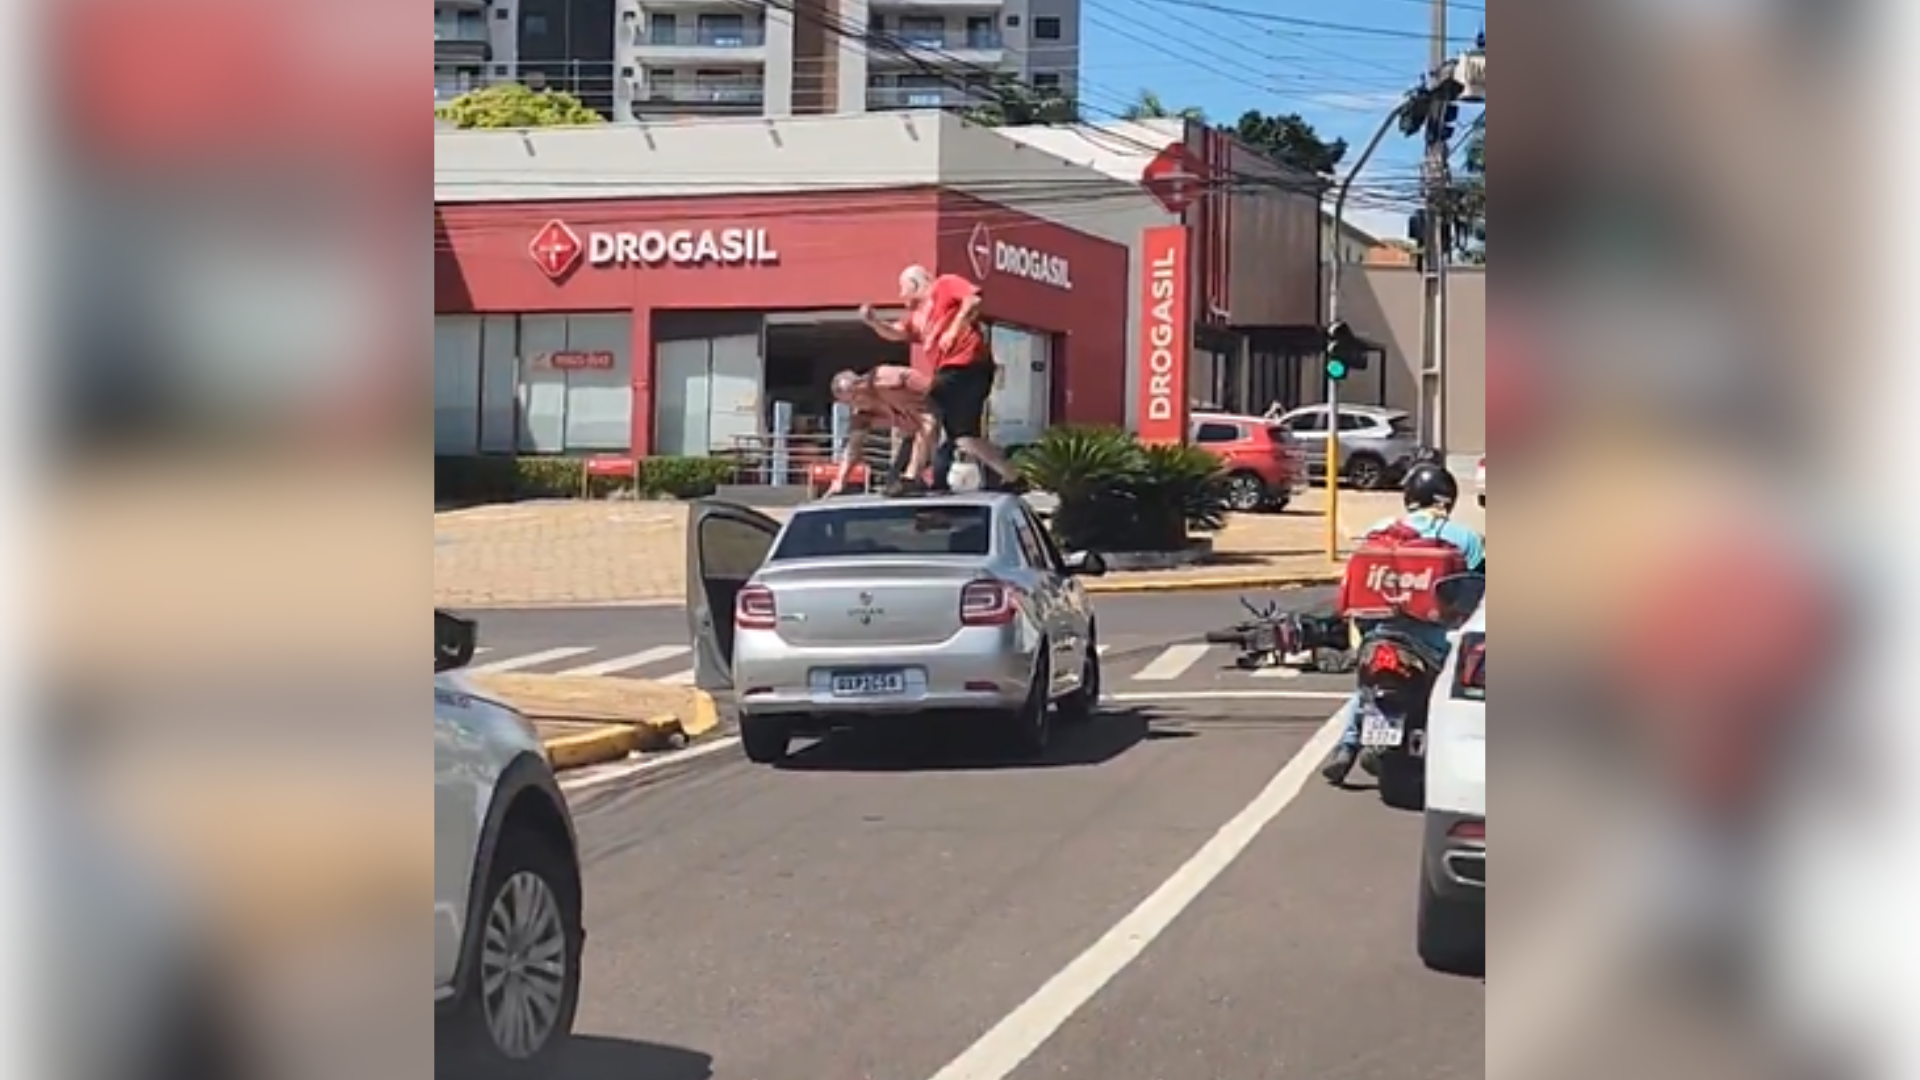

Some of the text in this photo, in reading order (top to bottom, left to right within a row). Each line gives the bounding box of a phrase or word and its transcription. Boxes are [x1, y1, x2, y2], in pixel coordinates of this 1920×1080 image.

[589, 228, 778, 264] DROGASIL
[995, 240, 1073, 290] DROGASIL
[1149, 247, 1175, 420] DROGASIL
